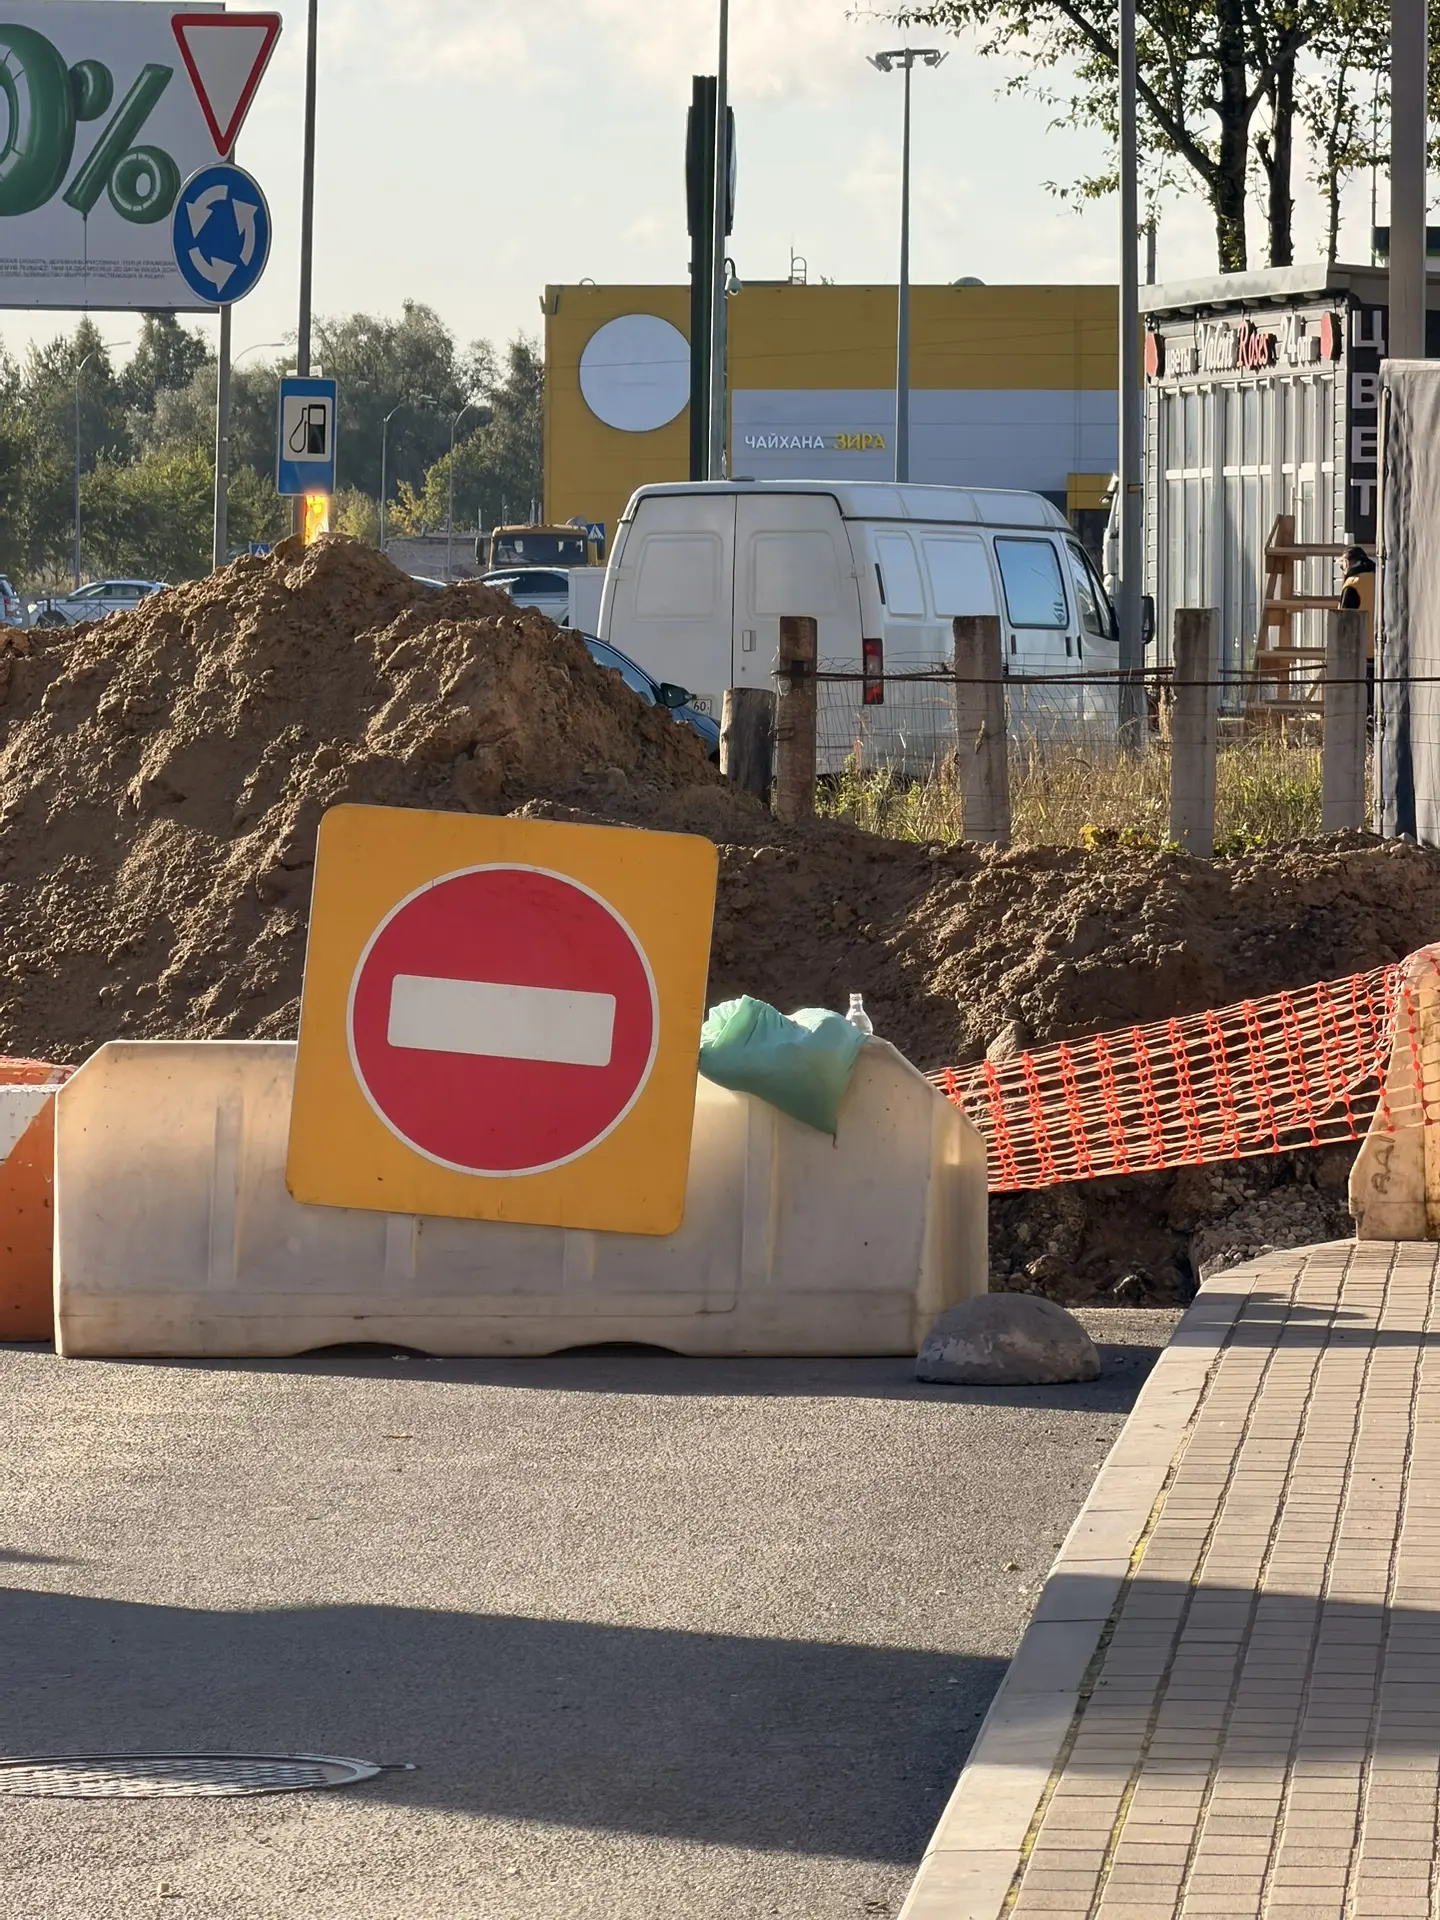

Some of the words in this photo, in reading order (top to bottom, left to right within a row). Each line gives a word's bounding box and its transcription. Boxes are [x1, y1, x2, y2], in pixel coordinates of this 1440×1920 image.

[1236, 321, 1269, 370] Roses
[1279, 314, 1297, 364] 24
[745, 432, 825, 449] ЧАЙХАНА
[833, 433, 886, 451] ЗИРА
